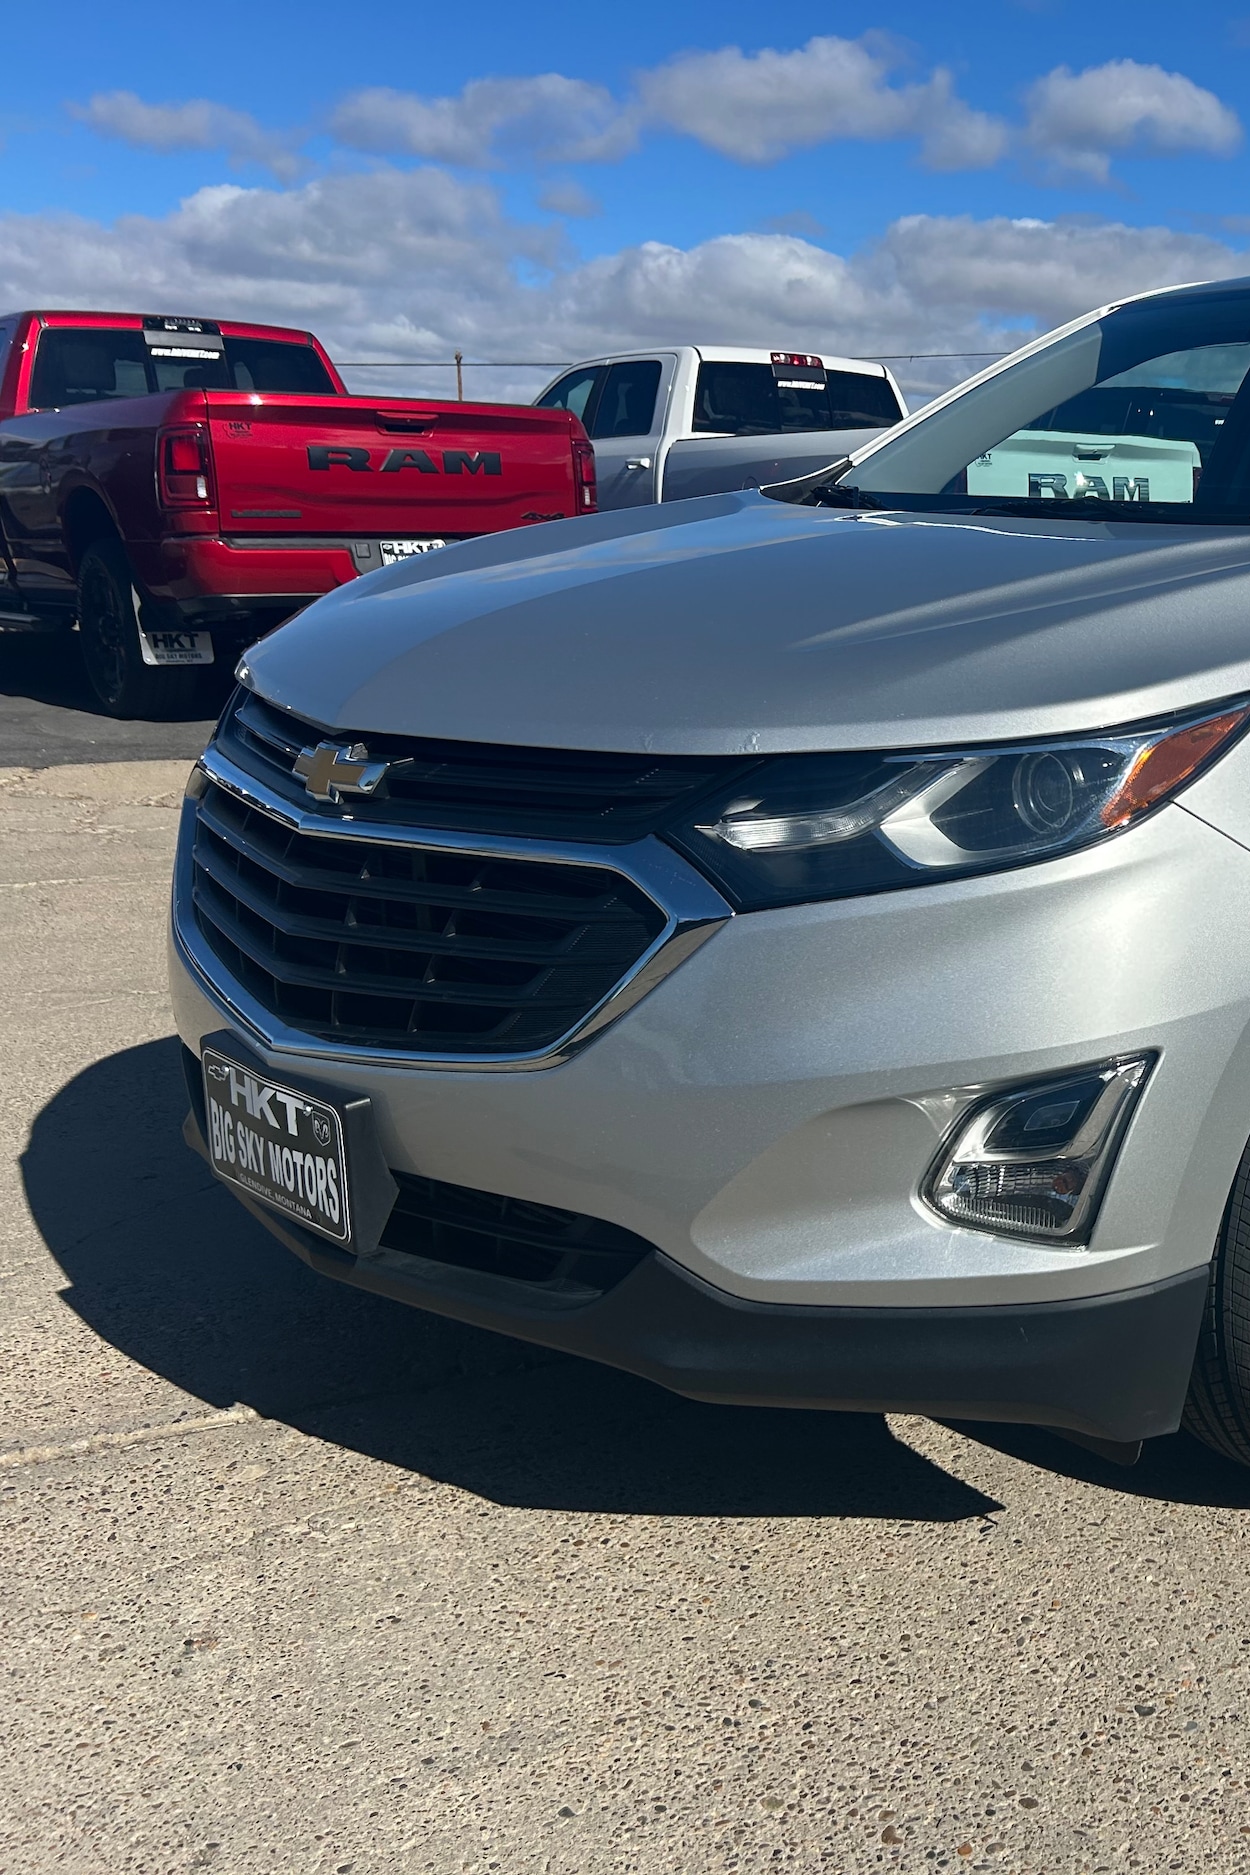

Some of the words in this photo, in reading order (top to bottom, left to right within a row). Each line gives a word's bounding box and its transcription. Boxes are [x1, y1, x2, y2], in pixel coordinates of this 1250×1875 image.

[228, 421, 252, 431] HKT
[307, 446, 502, 475] RAM
[1028, 472, 1150, 502] RAM
[392, 541, 430, 555] HKT
[152, 632, 198, 648] HKT
[229, 1068, 305, 1137] HKT
[209, 1097, 235, 1164] BIG
[237, 1120, 266, 1176] SKY
[268, 1141, 340, 1225] MOTORS
[239, 1173, 275, 1200] GLENDIVE,
[274, 1192, 313, 1220] MONTANA
